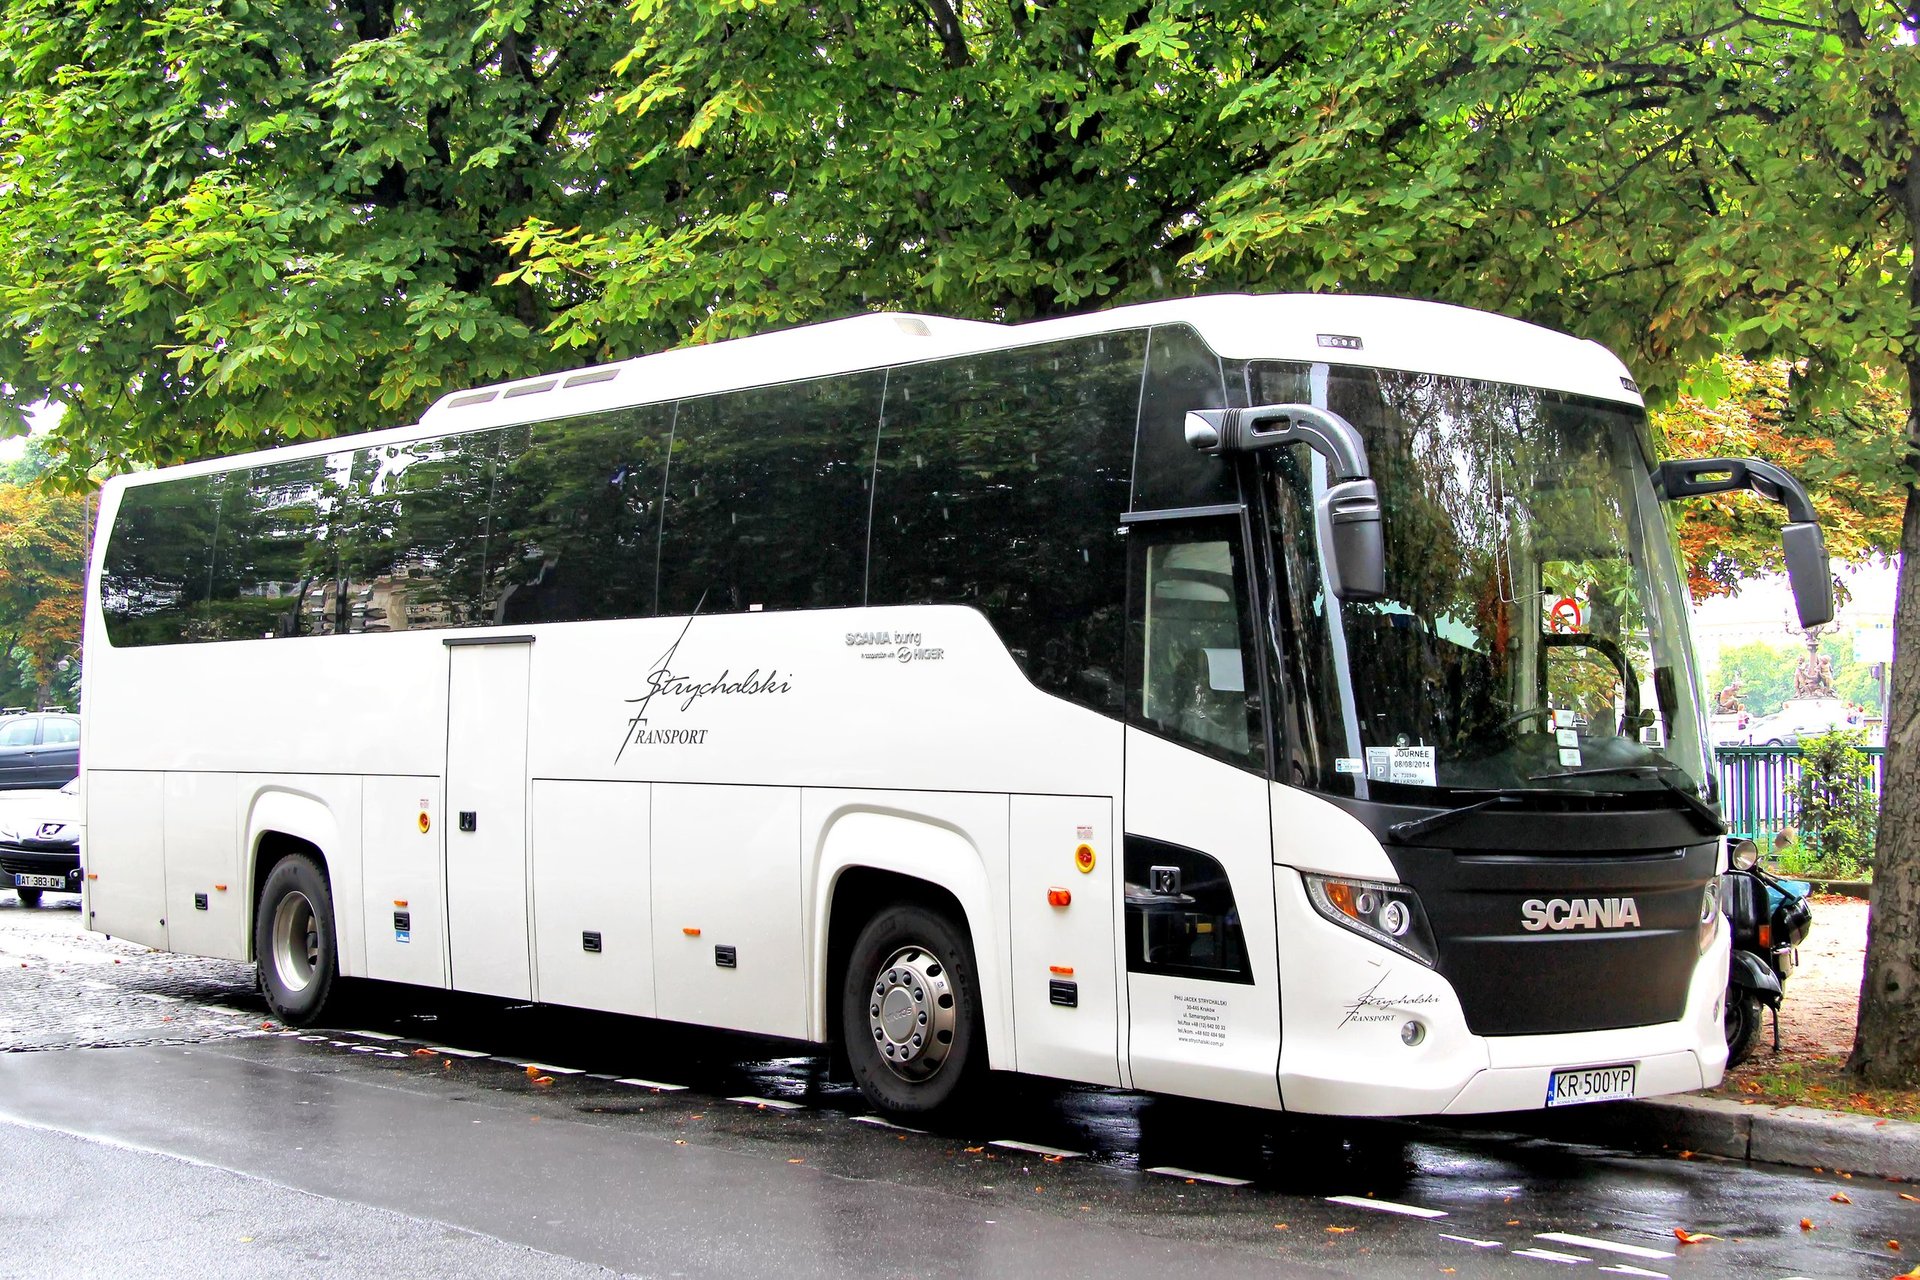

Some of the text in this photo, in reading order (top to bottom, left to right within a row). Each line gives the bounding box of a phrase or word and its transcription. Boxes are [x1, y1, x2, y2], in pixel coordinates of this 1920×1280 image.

[845, 631, 892, 646] SCANIA
[913, 647, 945, 660] HIGER
[624, 660, 793, 712] Strychalski
[620, 718, 709, 751] TRANSPORT
[1520, 897, 1641, 931] SCANIA
[1198, 998, 1227, 1006] STRYCHALSKI
[1344, 992, 1441, 1011] Strychalski
[1343, 1011, 1397, 1024] TRANSPORT
[1557, 1069, 1631, 1098] KR 500YP
